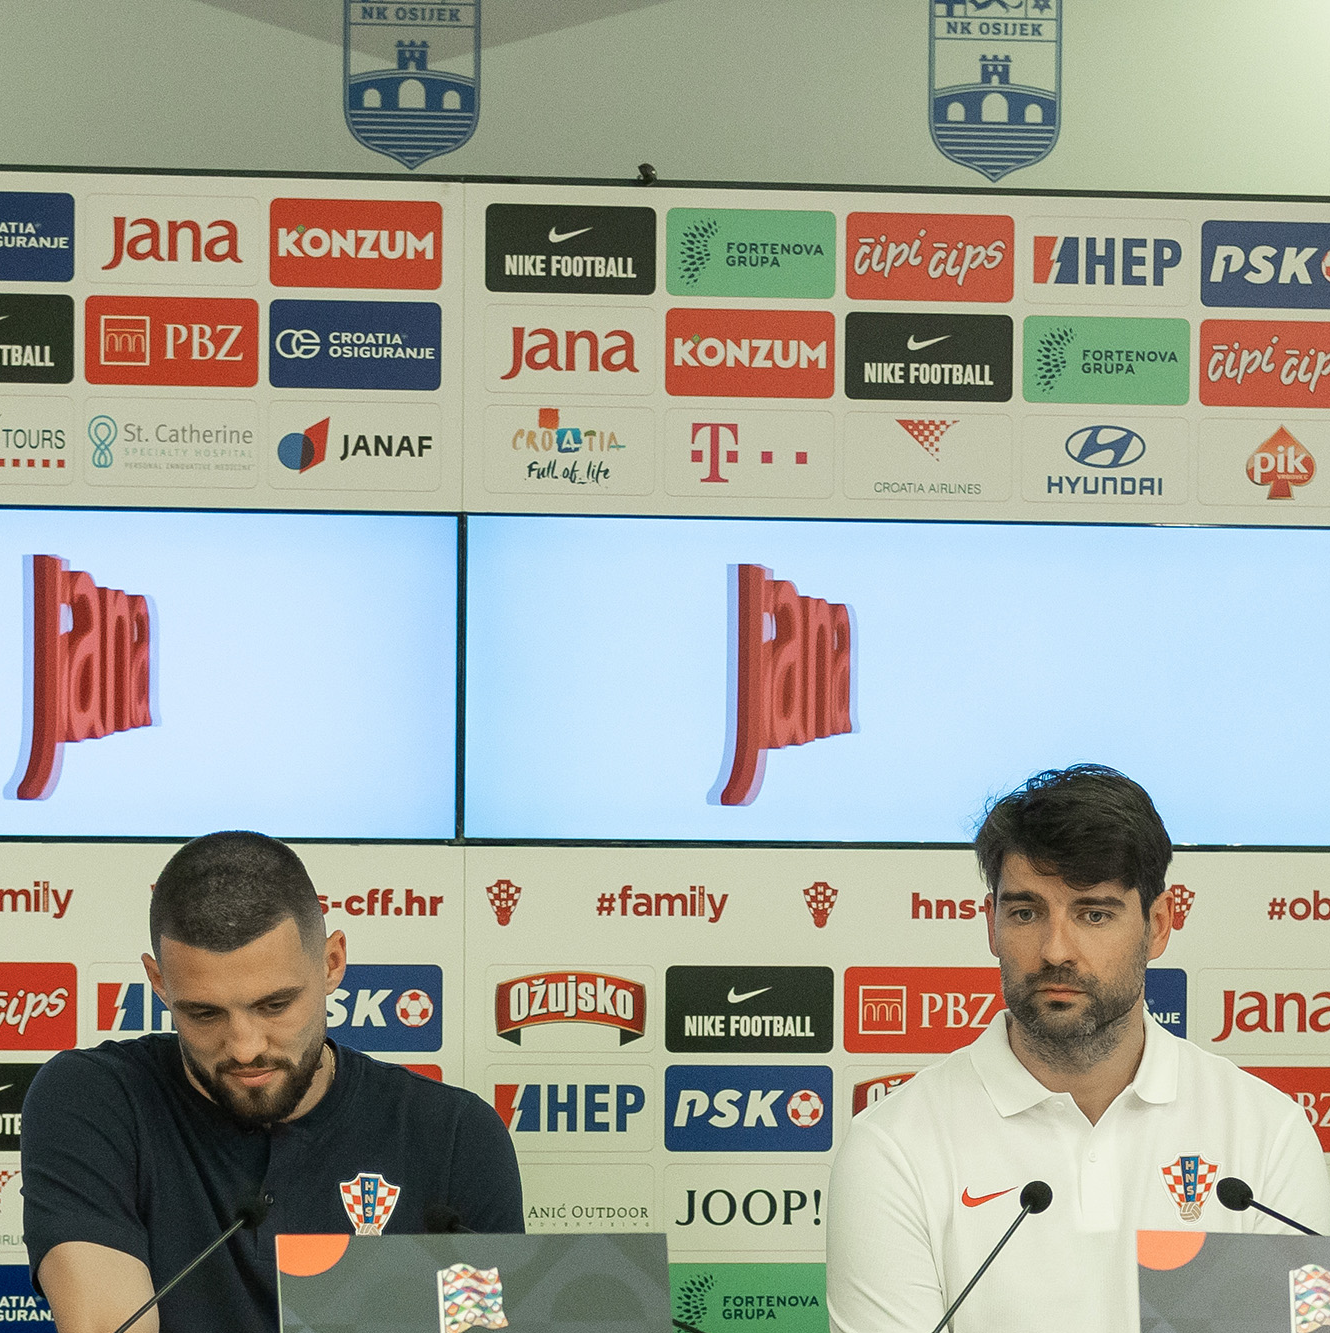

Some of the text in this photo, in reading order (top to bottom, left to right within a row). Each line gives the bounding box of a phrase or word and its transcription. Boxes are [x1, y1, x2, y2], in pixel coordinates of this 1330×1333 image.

[361, 7, 460, 21] NK OSIJEK
[947, 22, 1042, 36] NK OSIJEK
[278, 225, 433, 259] KONZUM
[727, 242, 824, 255] FORTENOVA
[505, 255, 637, 278] NIKE FOOTBALL
[726, 255, 780, 267] GRUPA
[1085, 237, 1182, 286] HEP
[1210, 246, 1318, 284] PSK
[165, 324, 243, 360] PBZ
[329, 332, 402, 344] CROATIA
[329, 346, 435, 359] OSIGURANJE
[674, 335, 826, 368] KONZUM
[1083, 350, 1178, 362] FORTENOVA
[864, 362, 994, 385] NIKE FOOTBALL
[1082, 362, 1135, 374] GRUPA
[2, 429, 65, 449] TOURS
[124, 423, 253, 444] St. Catherine
[513, 424, 625, 453] CROATIA
[340, 435, 432, 461] JANAF
[527, 460, 558, 479] Full
[562, 461, 579, 483] of
[1254, 446, 1306, 486] pik
[874, 482, 981, 495] CROATIA AIRLINES
[1048, 476, 1162, 495] HYUNDAI
[596, 885, 728, 923] #family
[509, 976, 633, 1022] Ožujsko
[919, 993, 996, 1030] PBZ
[685, 1015, 815, 1037] NIKE FOOTBALL
[547, 1084, 645, 1132] HEP
[674, 1089, 784, 1128] PSK
[675, 1189, 821, 1226] JOOP!
[723, 1296, 819, 1307] FORTENOVA
[722, 1309, 776, 1320] GRUPA
